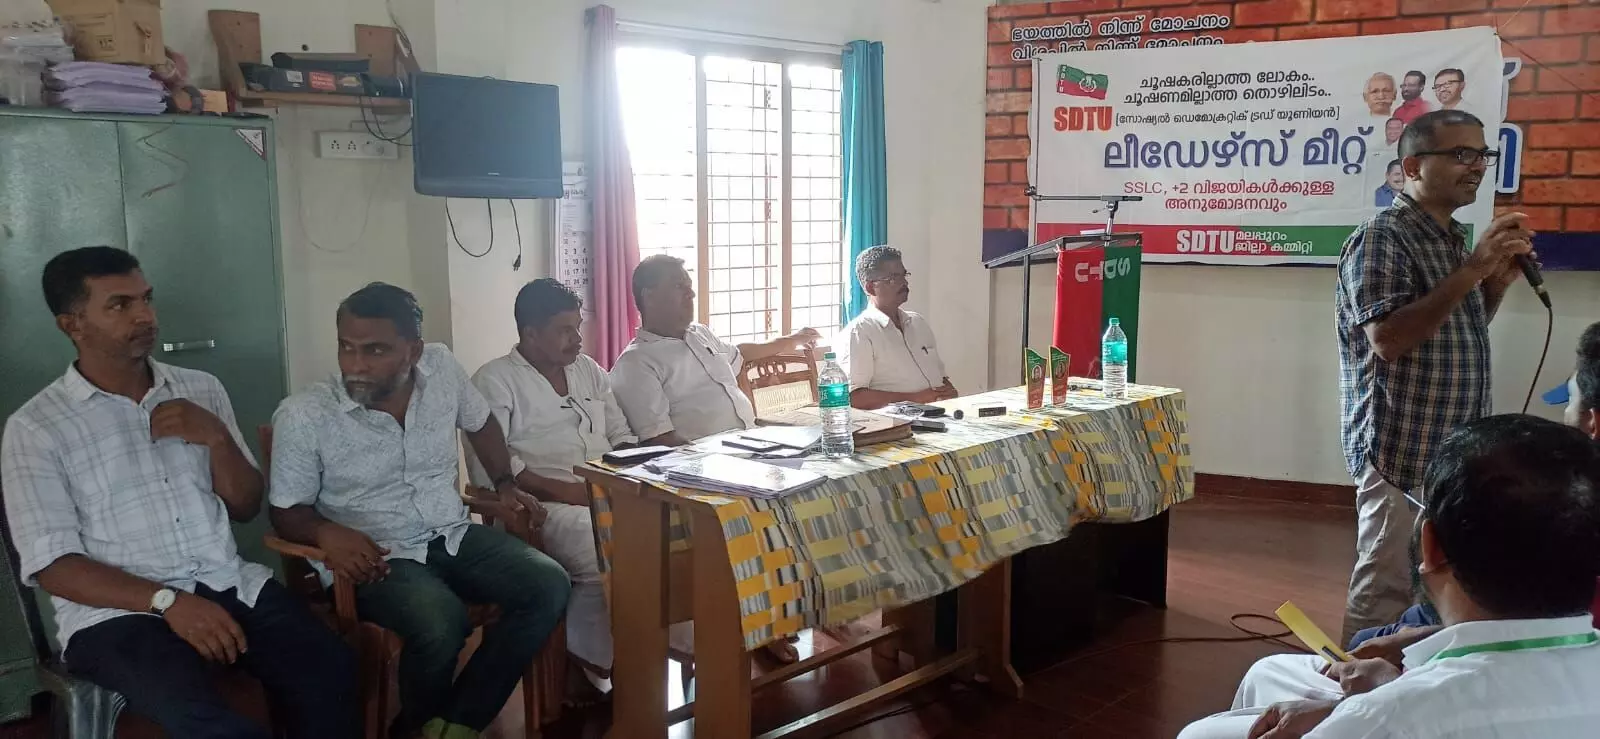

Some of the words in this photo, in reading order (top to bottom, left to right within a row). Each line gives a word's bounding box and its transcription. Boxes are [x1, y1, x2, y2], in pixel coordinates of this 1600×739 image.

[1012, 22, 1092, 41] ഭയത്തിൽ
[1098, 16, 1145, 36] നിന്ന്
[1150, 15, 1230, 32] മോചനം
[1139, 72, 1251, 90] ചൂഷകരില്ലാത്ത
[1256, 71, 1315, 83] ലോകം..
[1124, 89, 1238, 106] ചൂഷണമില്ലാത്ത
[1243, 83, 1331, 99] തൊഴിലിടം..
[1054, 106, 1113, 131] SDTU
[1104, 129, 1296, 168] ലീഡേഴ്സ്
[1303, 126, 1374, 175] മീറ്റ്
[1124, 181, 1167, 196] SSLC,
[1172, 182, 1188, 194] +2
[1193, 179, 1335, 196] വിജയികൾക്കുള്ള
[1165, 197, 1287, 212] അനുമോദനവും
[1177, 229, 1235, 253] SDTU
[1235, 241, 1267, 254] ജില്ലാ
[1270, 241, 1313, 254] കമ്മിറ്റി
[1236, 231, 1288, 242] മലപ്പുറം
[1075, 257, 1131, 283] SDTU
